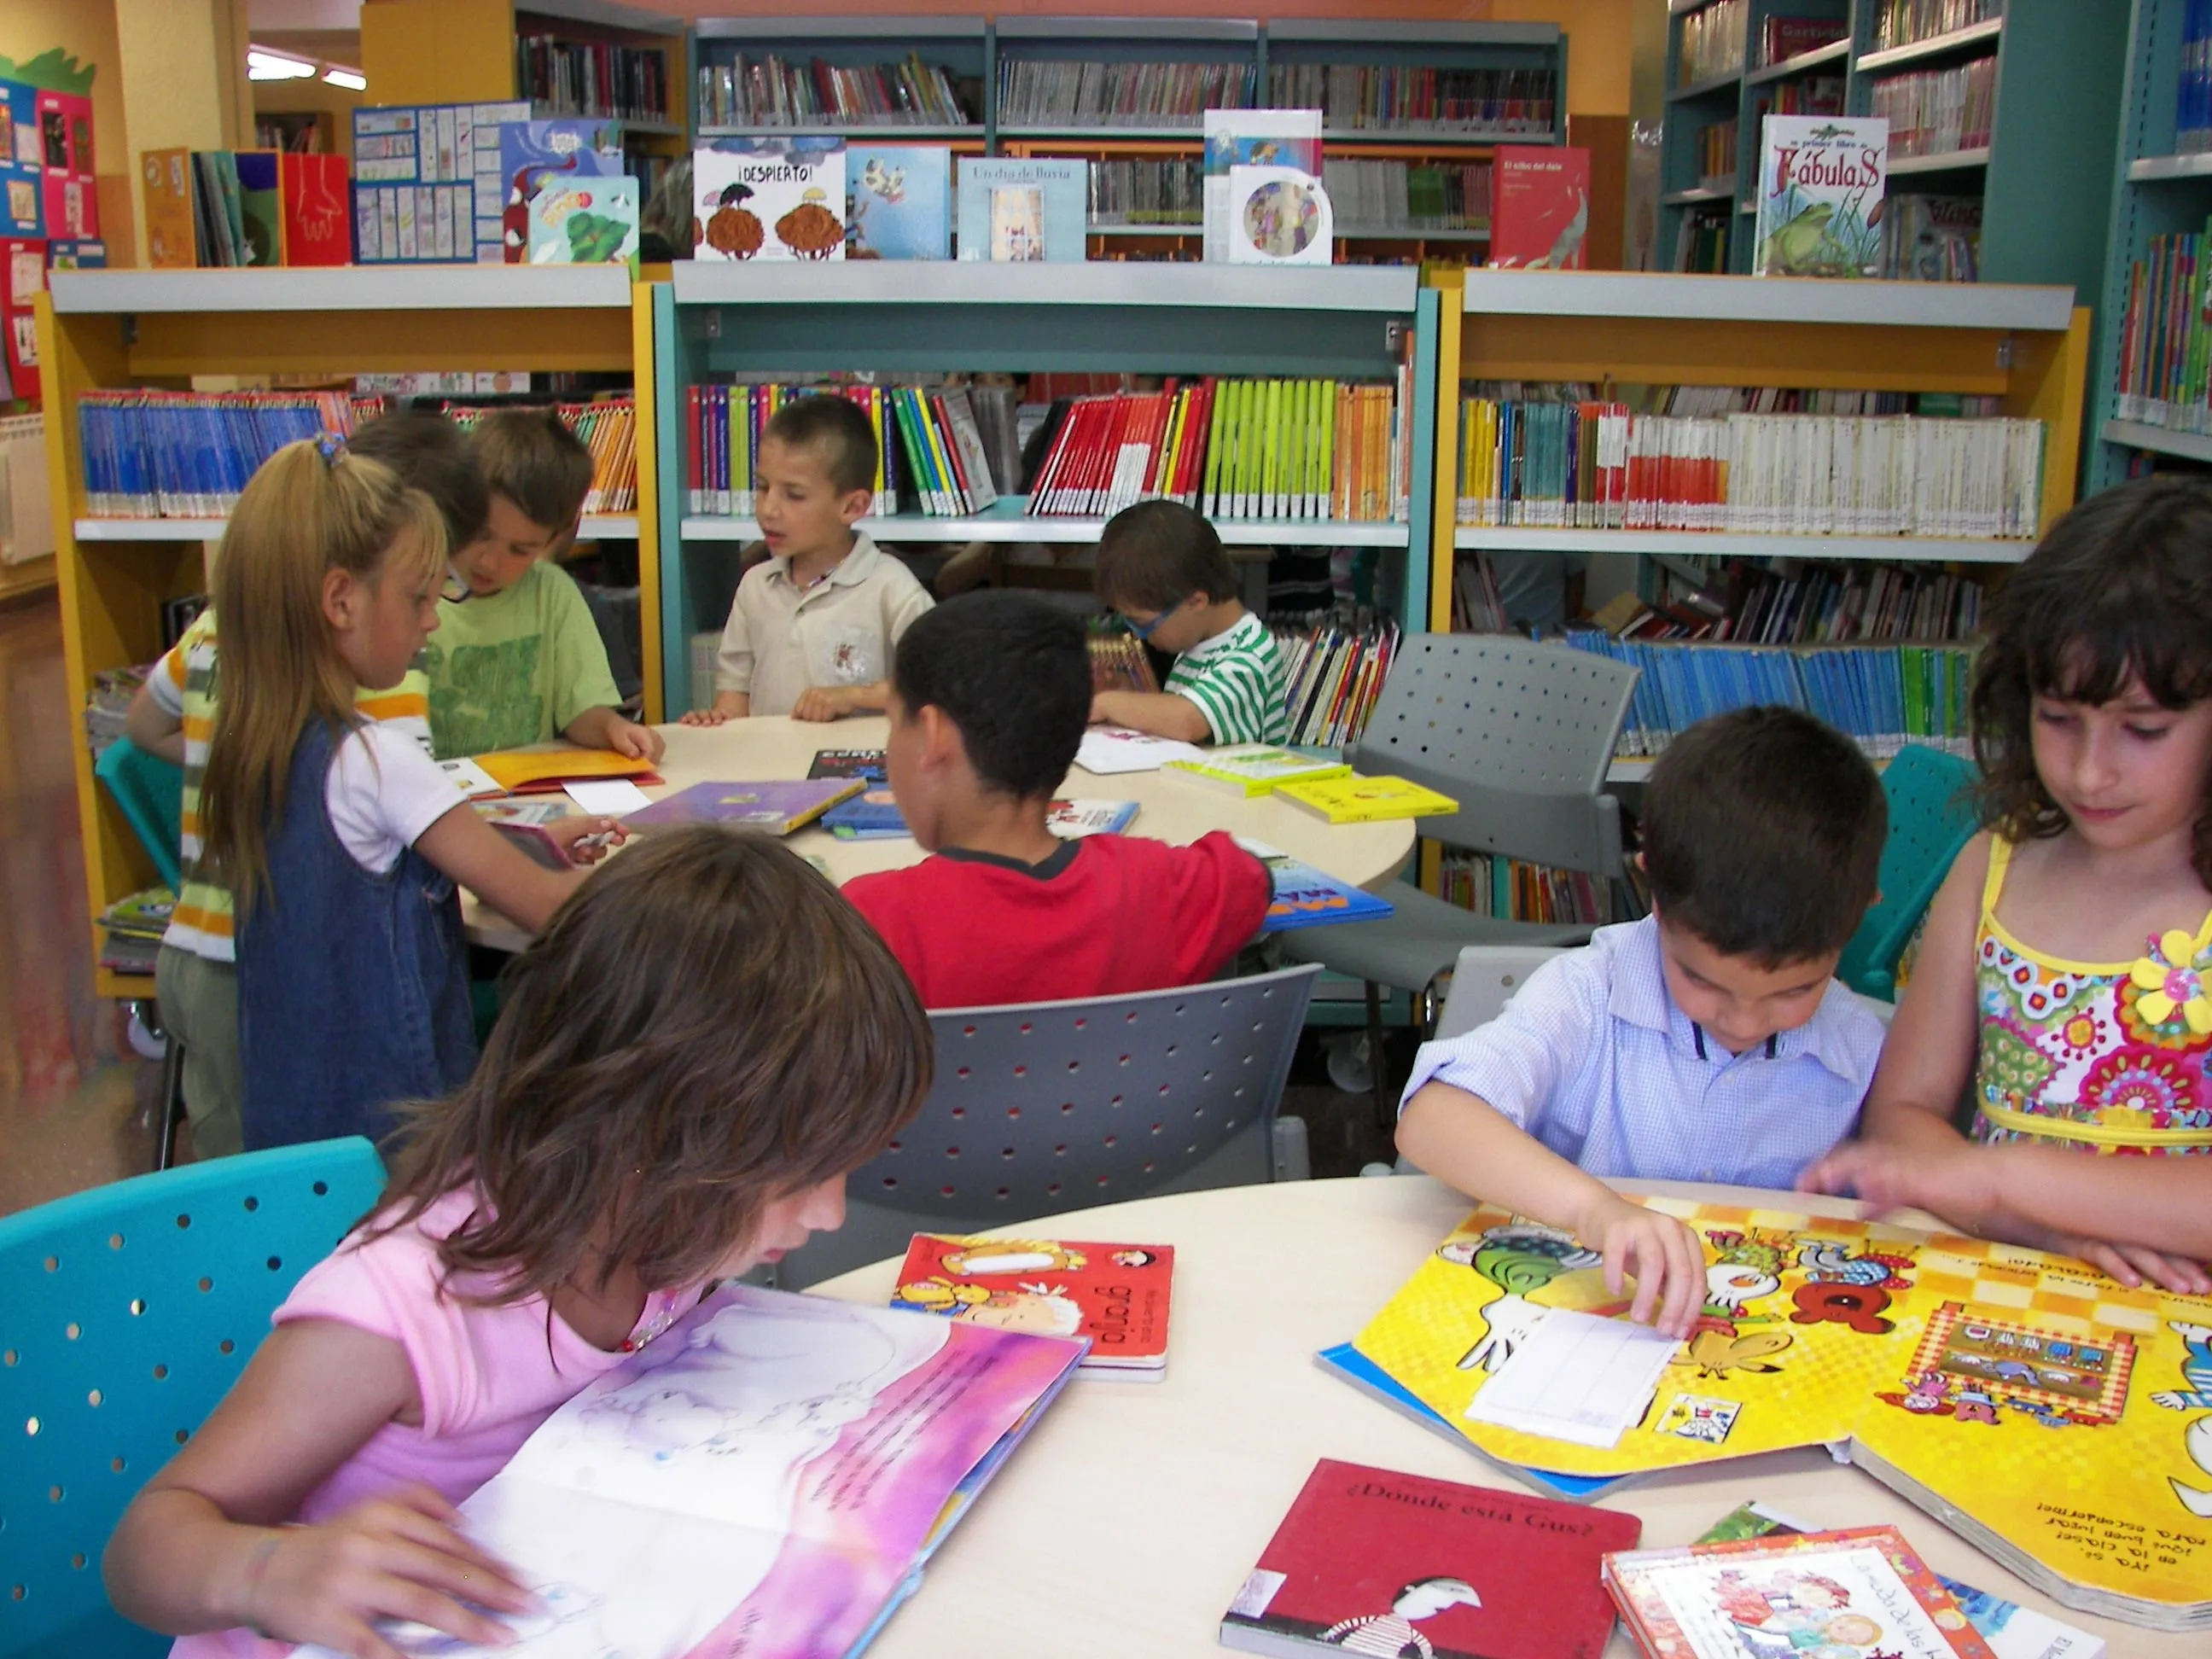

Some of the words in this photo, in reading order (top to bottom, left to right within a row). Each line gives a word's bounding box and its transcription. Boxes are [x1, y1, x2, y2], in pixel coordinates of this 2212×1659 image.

[738, 165, 812, 183] ¡DESPIERTO!
[973, 166, 992, 179] Un
[1018, 166, 1032, 178] de
[1035, 166, 1071, 179] lluvia
[1089, 1285, 1135, 1343] granja
[1461, 1503, 1513, 1524] está
[1524, 1512, 1594, 1537] Gus?
[2036, 1502, 2145, 1533] esconderme!
[2045, 1517, 2094, 1534] lugar
[2056, 1530, 2117, 1551] clase!
[2104, 1530, 2144, 1546] buen
[2128, 1546, 2148, 1560] la
[2158, 1554, 2177, 1565] en
